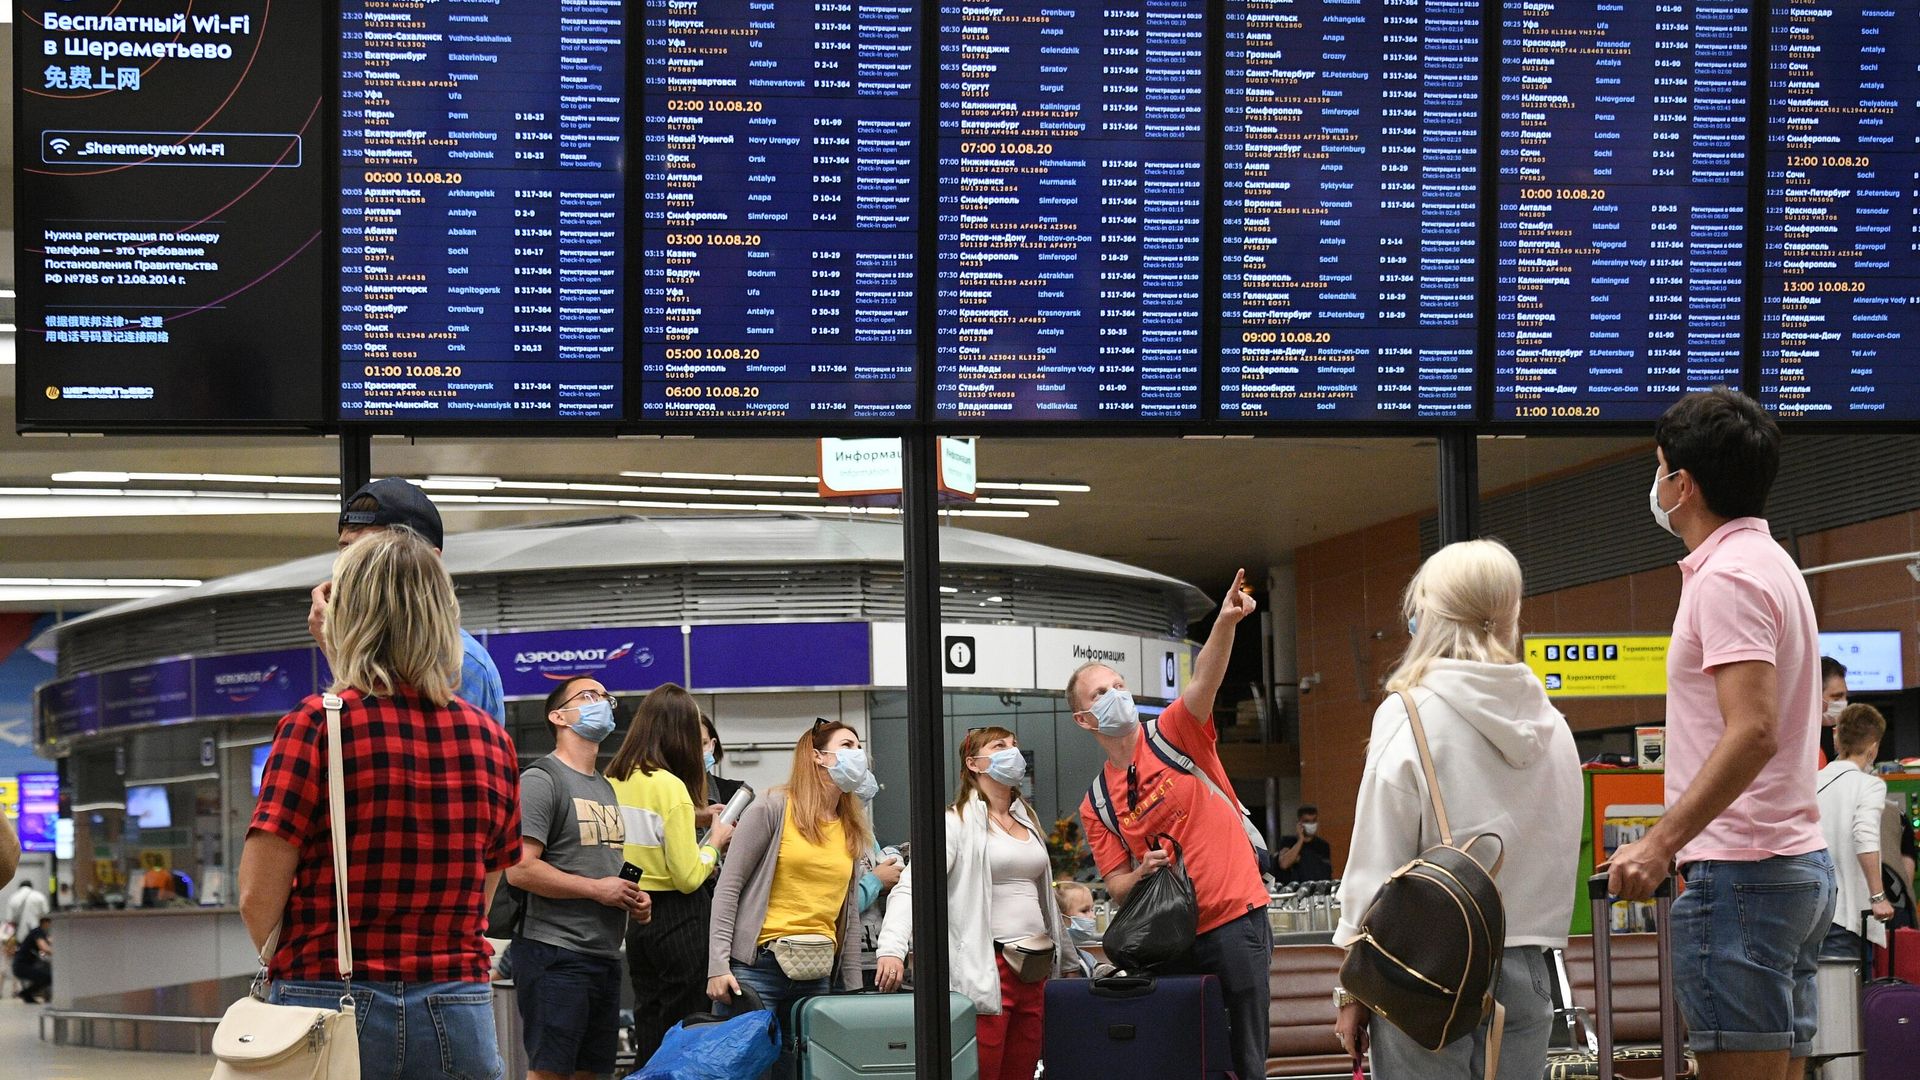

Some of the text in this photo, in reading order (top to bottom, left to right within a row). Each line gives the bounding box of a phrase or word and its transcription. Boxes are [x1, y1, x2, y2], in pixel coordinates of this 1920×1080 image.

[44, 12, 249, 34] Бесплатный Wi-Fi
[343, 32, 511, 43] 23:20 Южно-Сахалинск Yuzhno-Sakhalinsk
[44, 38, 232, 59] в Шереметьево
[962, 44, 1009, 54] Геленджик
[1041, 46, 1079, 56] Gelendzhik
[44, 66, 140, 90] 免费上网
[1246, 69, 1315, 80] Санкт-Петербург
[646, 77, 805, 87] 01:50 Нижневартовск Nizhnevartovsk
[1522, 94, 1569, 103] Н.Новгород
[1595, 96, 1635, 104] N.Novgorod
[1788, 99, 1828, 107] Челябинск
[1859, 100, 1898, 108] Chelyabinsk
[668, 100, 762, 111] 02:00 10.08.20
[365, 129, 427, 140] Екатеринбург
[447, 131, 497, 141] Ekaterinburg
[668, 134, 696, 144] Новый
[698, 135, 734, 145] Уренгой
[749, 136, 767, 145] Novy
[769, 137, 800, 146] Urengoy
[189, 144, 224, 155] Wi-Fi
[961, 143, 1052, 154] 07:00 10.08.20
[1788, 157, 1869, 166] 12:00 10.08.20
[365, 172, 462, 183] 00:00 10.08.20
[342, 188, 495, 198] 00:05 Архангельск Arkhangelsk
[1521, 189, 1605, 199] 10:00 10.08.20
[45, 231, 219, 243] Нужна регистрация по номеру
[667, 234, 760, 245] 03:00 10.08.20
[939, 234, 1092, 244] 07:30 Ростов-на-Дону Rostov-on-Don
[45, 245, 204, 256] телефона это требование
[1784, 242, 1830, 251] Ставрополь
[1855, 243, 1885, 251] Stavropol
[645, 250, 664, 258] 03:15
[667, 250, 696, 258] Казань
[45, 259, 218, 270] Постановления Правительства
[45, 274, 62, 283] РФ
[65, 274, 98, 283] №785
[118, 275, 176, 284] 12.08.2014
[1518, 277, 1570, 286] Калининград
[1591, 277, 1629, 286] Kaliningrad
[342, 285, 363, 293] 00:40
[364, 285, 427, 294] Магнитогорск
[448, 286, 500, 295] Magnitogorsk
[1784, 282, 1865, 291] 13:00 10.08.20
[1243, 333, 1330, 342] 09:00 10.08.20
[1781, 332, 1841, 341] Ростов-на-Дону
[666, 349, 759, 359] 05:00 10.08.20
[1516, 349, 1583, 359] Санкт-Петербург
[365, 366, 461, 376] 01:00 10.08.20
[666, 387, 759, 397] 06:00 10.08.20
[937, 384, 1065, 393] 07:50 Стамбул Istanbul
[1221, 384, 1357, 394] 09:05 Новосибирск Novosibirsk
[342, 401, 362, 409] 01:00
[364, 400, 438, 410] Ханты-Мансийск
[448, 401, 511, 410] Khanty-Mansiysk
[521, 401, 551, 409] 317-364
[644, 402, 663, 410] 06:00
[665, 402, 717, 412] Н.Новгород
[746, 403, 789, 411] N.Novgorod
[958, 402, 1012, 412] Владикавказ
[1241, 403, 1262, 411] Сочи
[1516, 407, 1599, 416] 11:00 10.08.20
[836, 449, 903, 463] Информац
[514, 649, 607, 664] АЭРОФЛОТ
[1073, 644, 1125, 662] Информация
[1547, 646, 1558, 659] B
[1566, 646, 1577, 659] C
[1586, 646, 1596, 659] E
[1605, 646, 1614, 659] F
[1123, 777, 1174, 827] PROTEST
